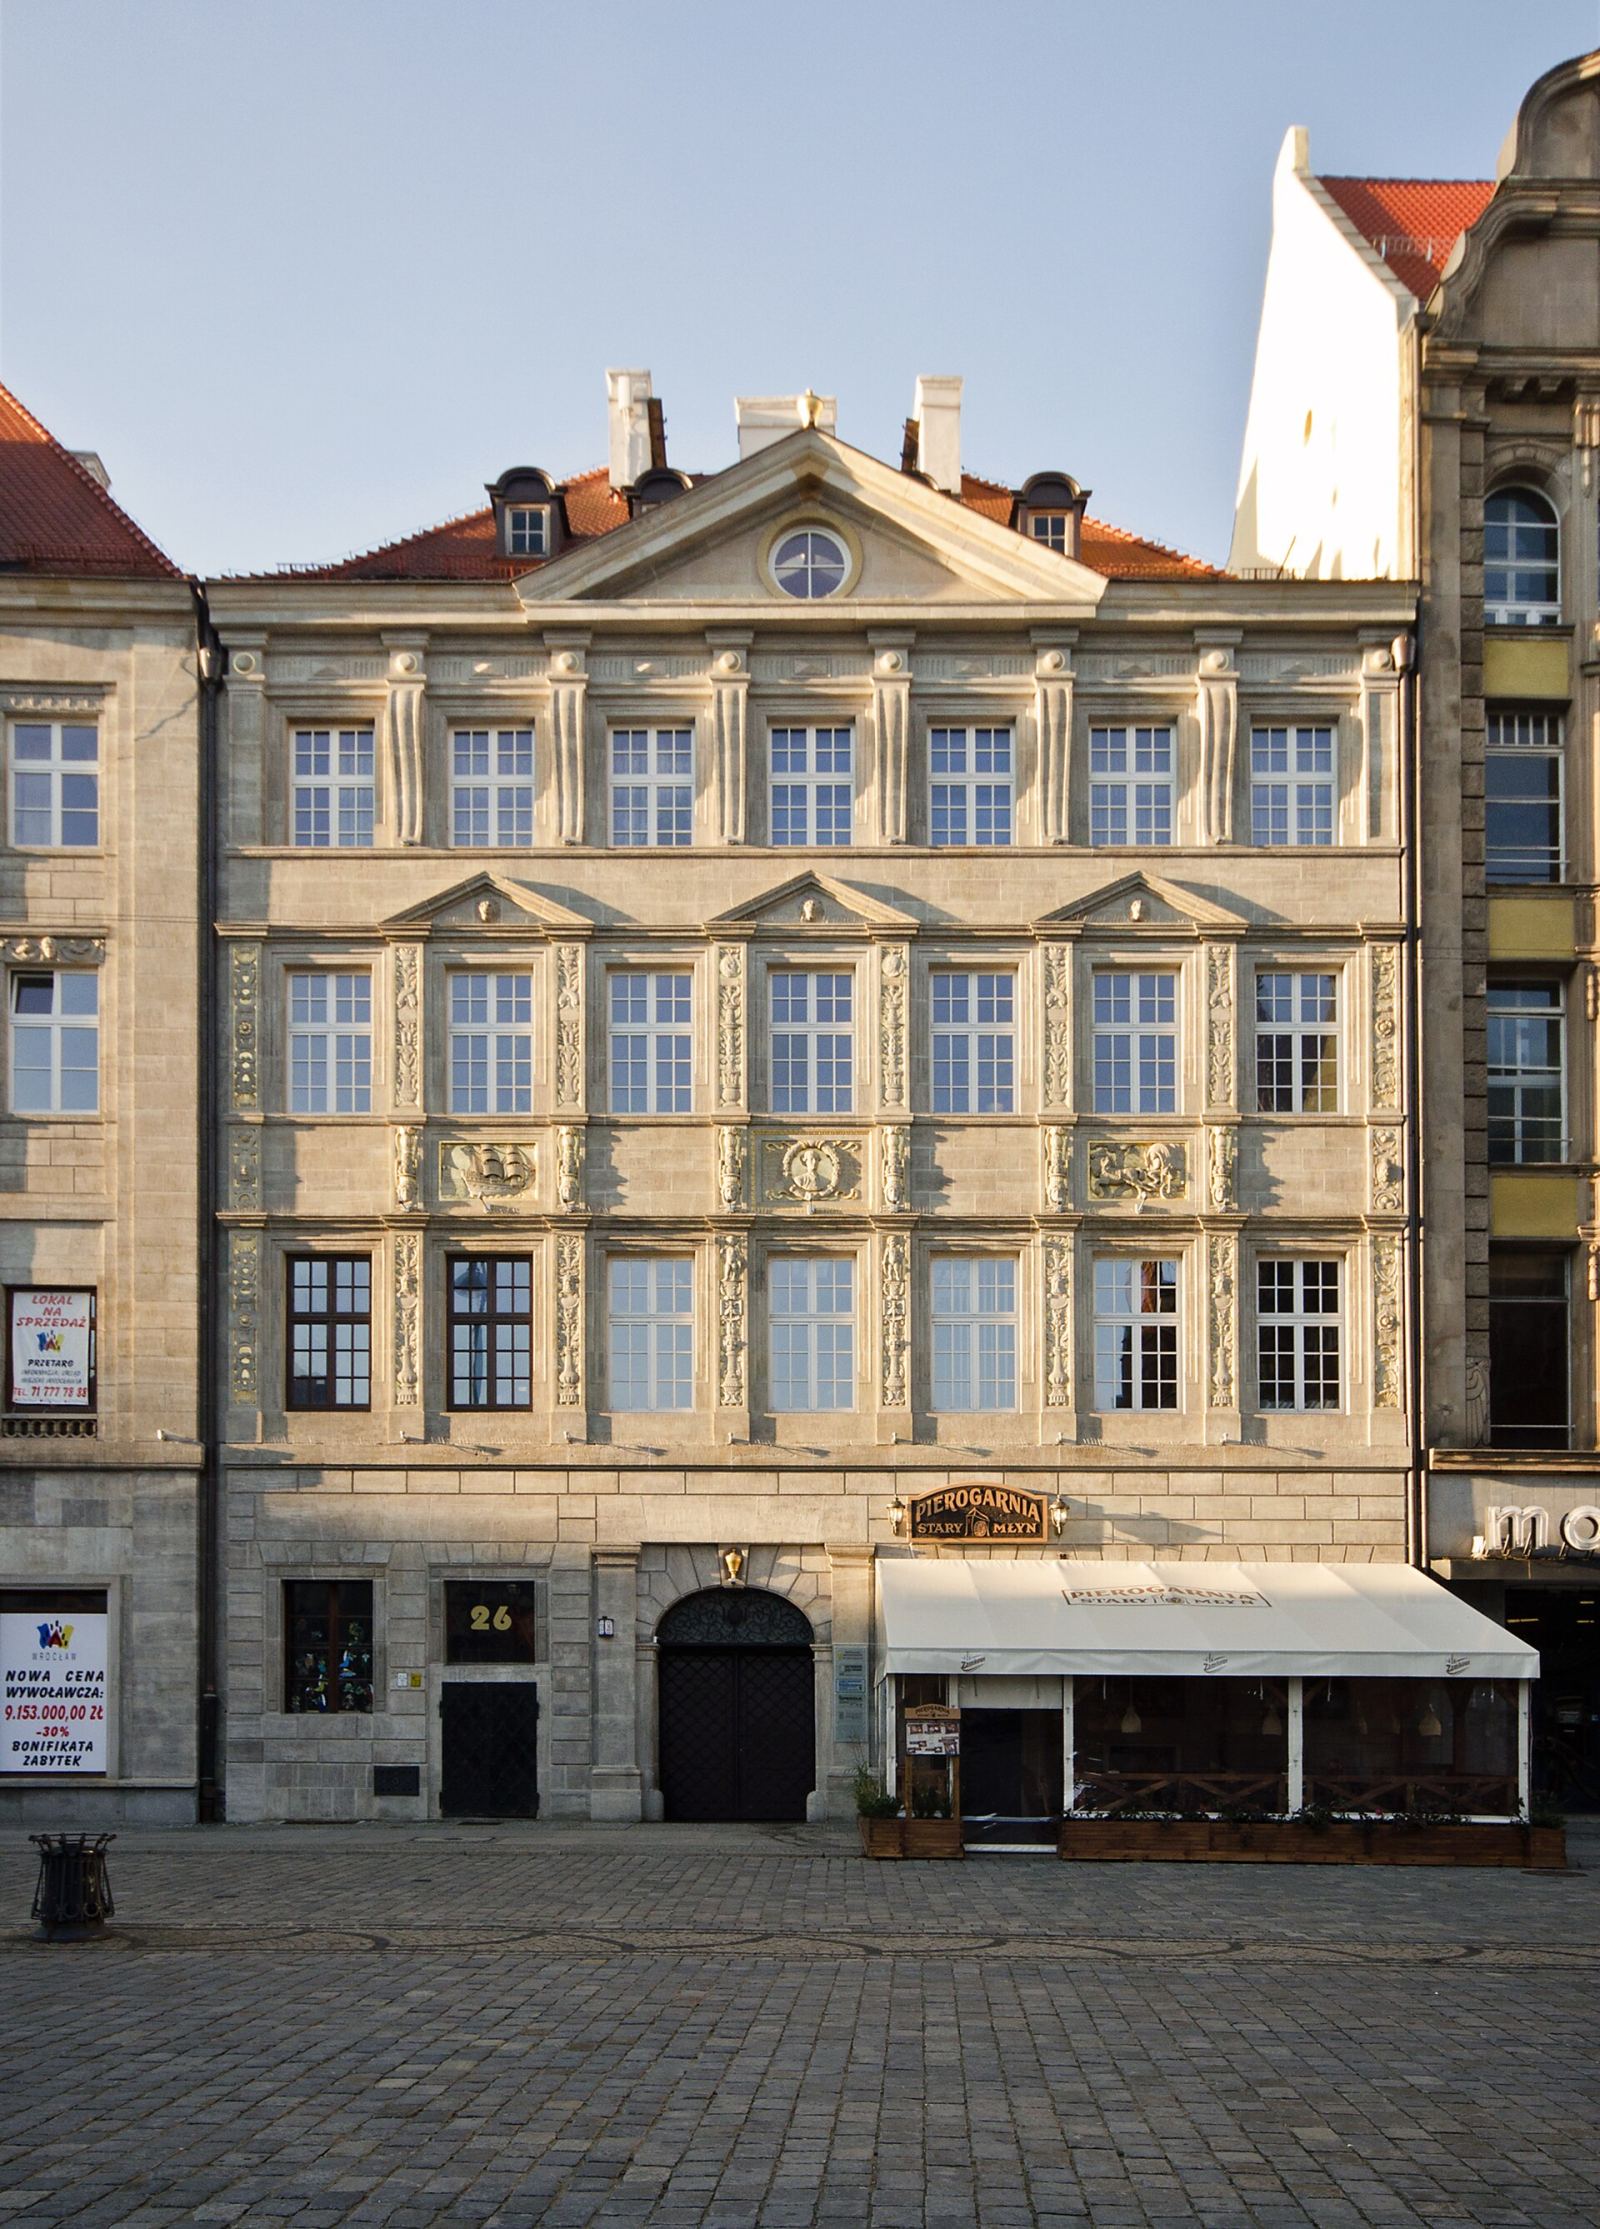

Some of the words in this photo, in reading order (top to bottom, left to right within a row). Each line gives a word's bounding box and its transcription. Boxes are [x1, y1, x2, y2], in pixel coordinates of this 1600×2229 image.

[32, 1295, 73, 1305] LOKAL
[42, 1307, 62, 1316] NA
[16, 1316, 86, 1328] SPRZEDAŻ
[28, 1359, 74, 1368] PRZETARG
[31, 1386, 41, 1397] 71
[44, 1386, 60, 1397] 777
[916, 1487, 1040, 1522] PIEROGARNIA
[918, 1522, 963, 1534] STARY
[992, 1522, 1037, 1534] MŁYN
[1070, 1586, 1257, 1601] PIEROGARNIA
[470, 1605, 512, 1631] 26
[32, 1652, 77, 1661] WROCŁAW
[5, 1670, 50, 1682] NOWA
[65, 1670, 104, 1682] CENA
[6, 1686, 104, 1699] WYWOŁAWCZA:
[5, 1705, 86, 1722] 9.153.000,00
[90, 1704, 104, 1720] ZŁ
[36, 1726, 69, 1737] -30%
[12, 1741, 93, 1752] BONIFIKATA
[23, 1755, 82, 1767] ZABYTEK
